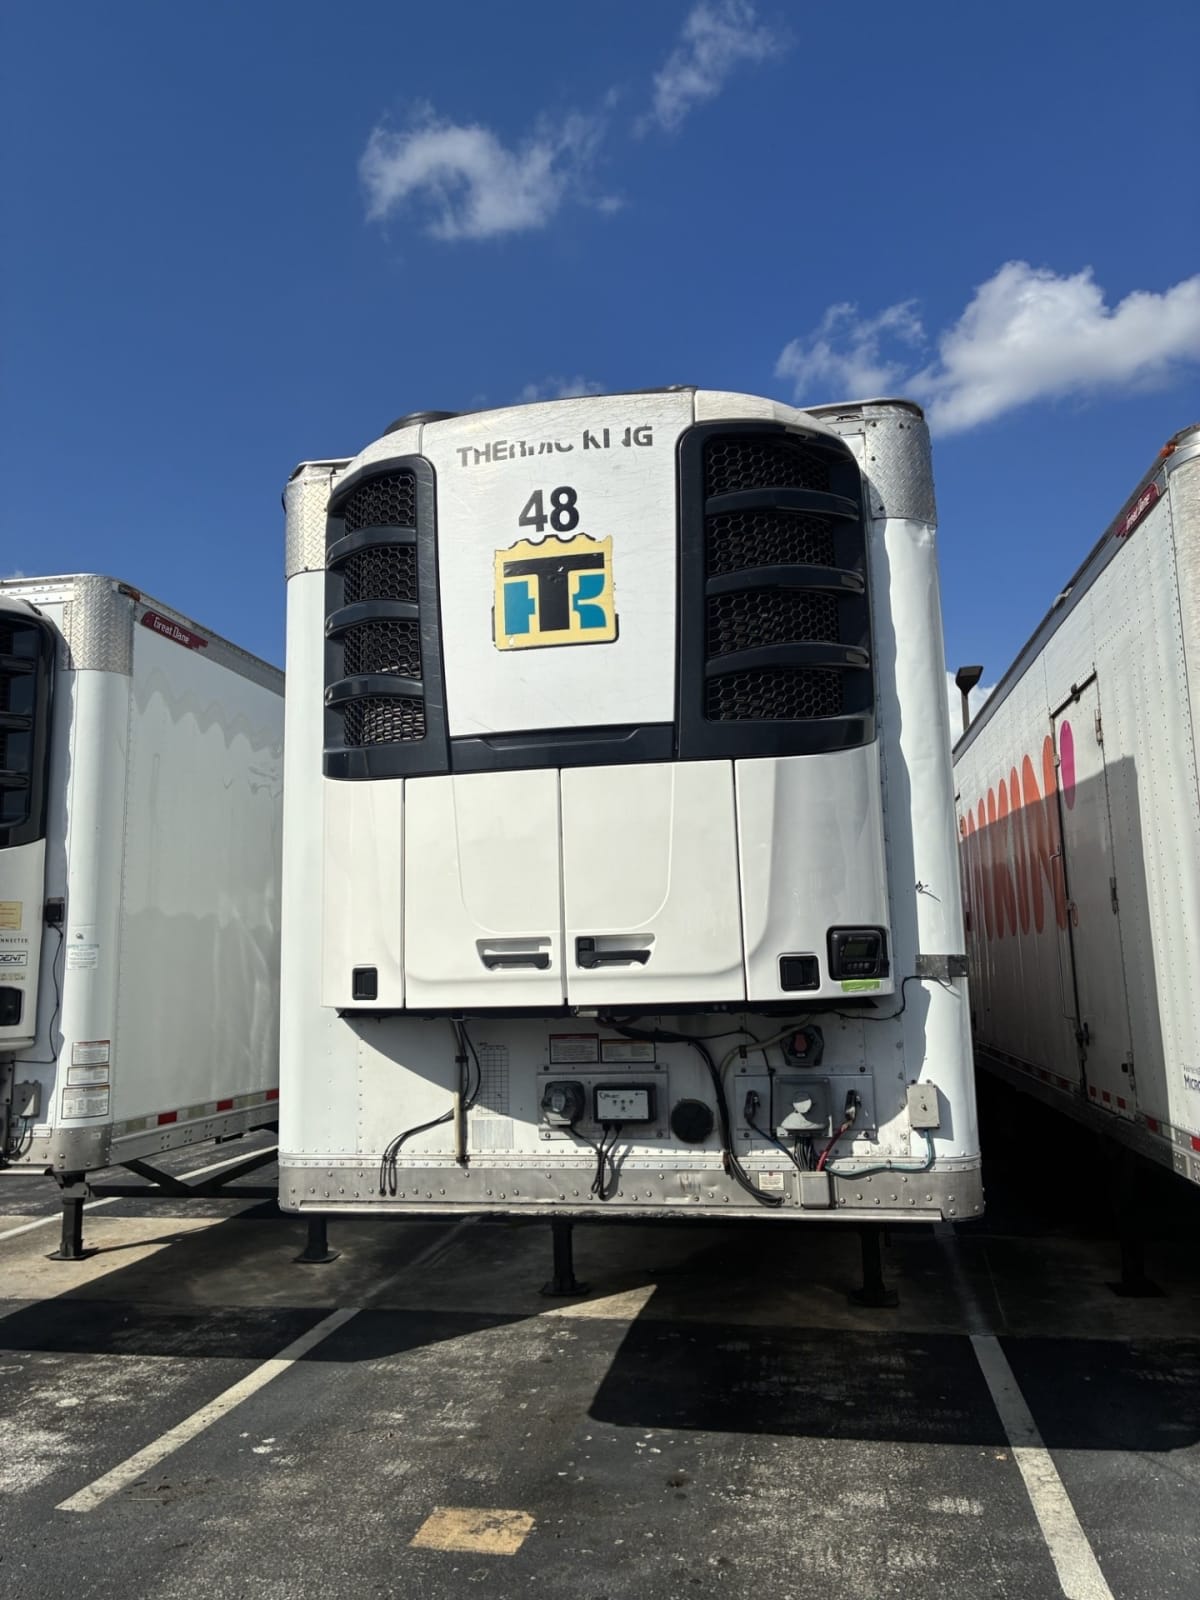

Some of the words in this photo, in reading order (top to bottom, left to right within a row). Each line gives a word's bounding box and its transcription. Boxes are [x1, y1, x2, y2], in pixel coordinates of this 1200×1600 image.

[518, 486, 580, 533] 48
[153, 616, 172, 635] Great
[172, 626, 190, 643] Dane
